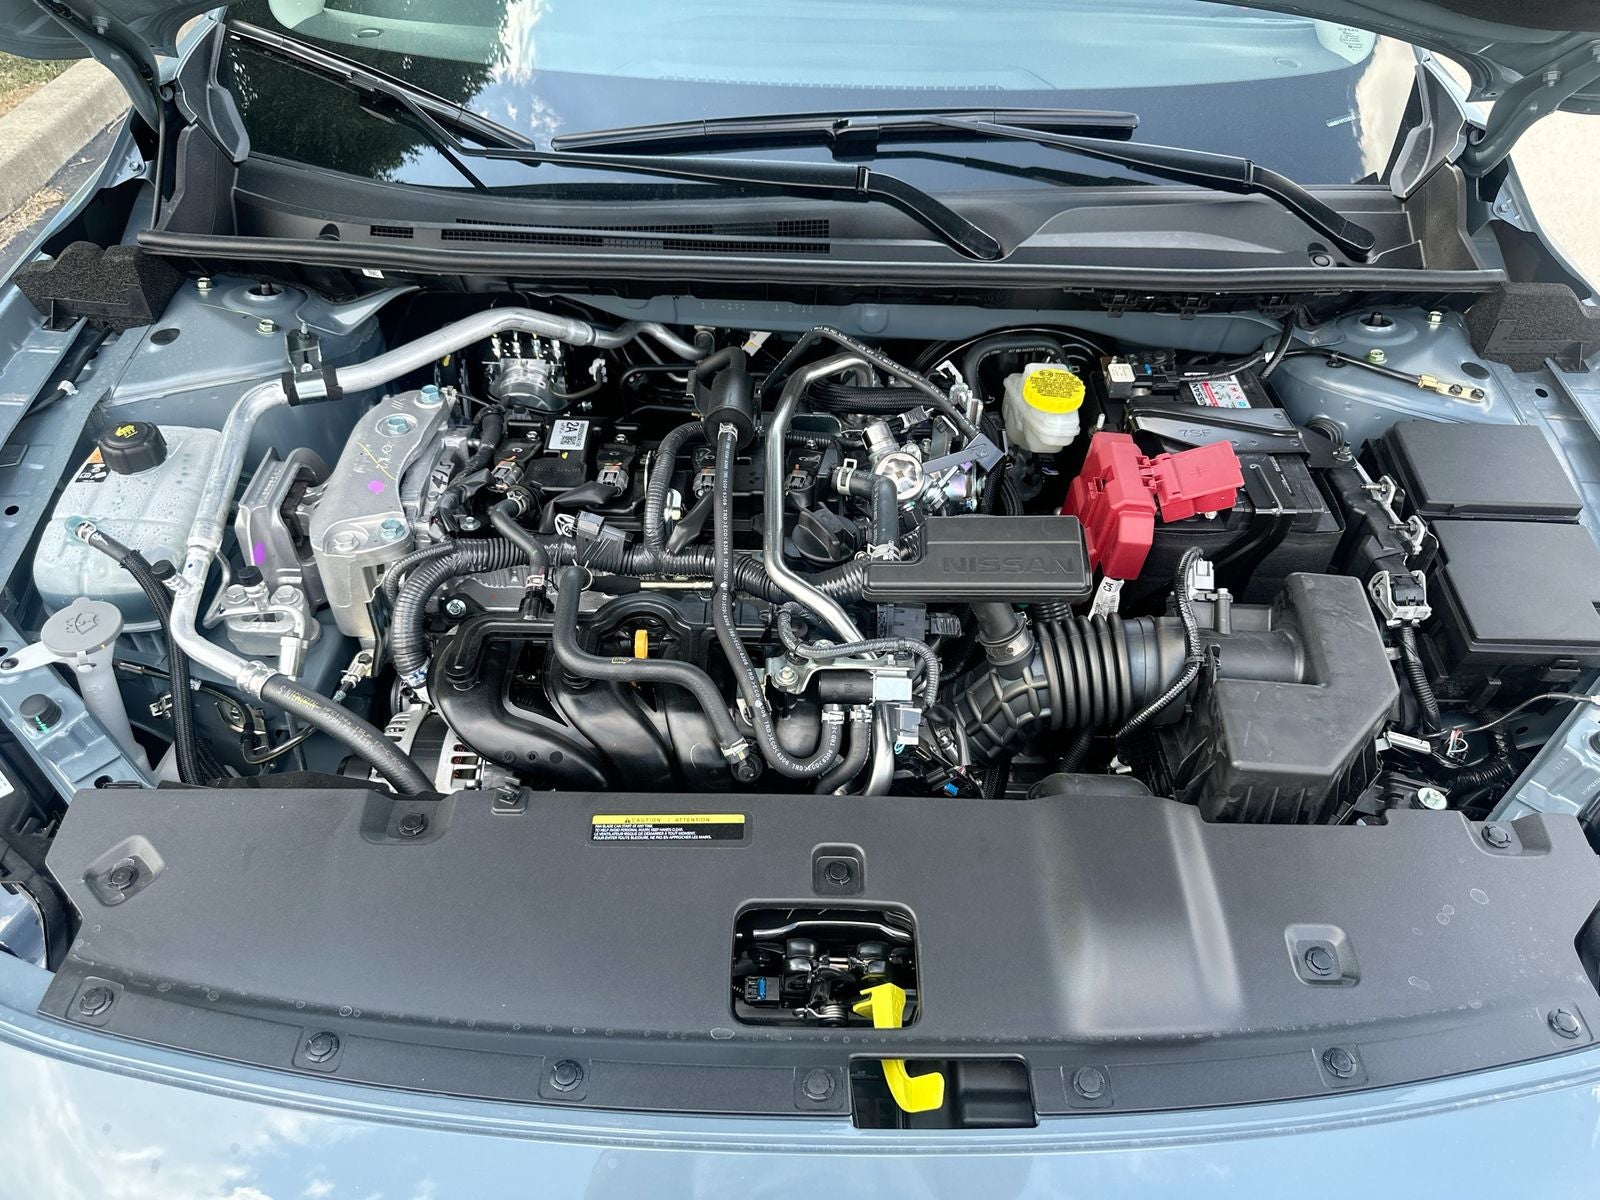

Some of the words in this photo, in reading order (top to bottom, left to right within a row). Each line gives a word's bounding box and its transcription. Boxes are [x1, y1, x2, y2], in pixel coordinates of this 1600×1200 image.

[565, 422, 579, 433] 2A
[943, 557, 1075, 574] NISSAN
[1103, 582, 1114, 592] CA
